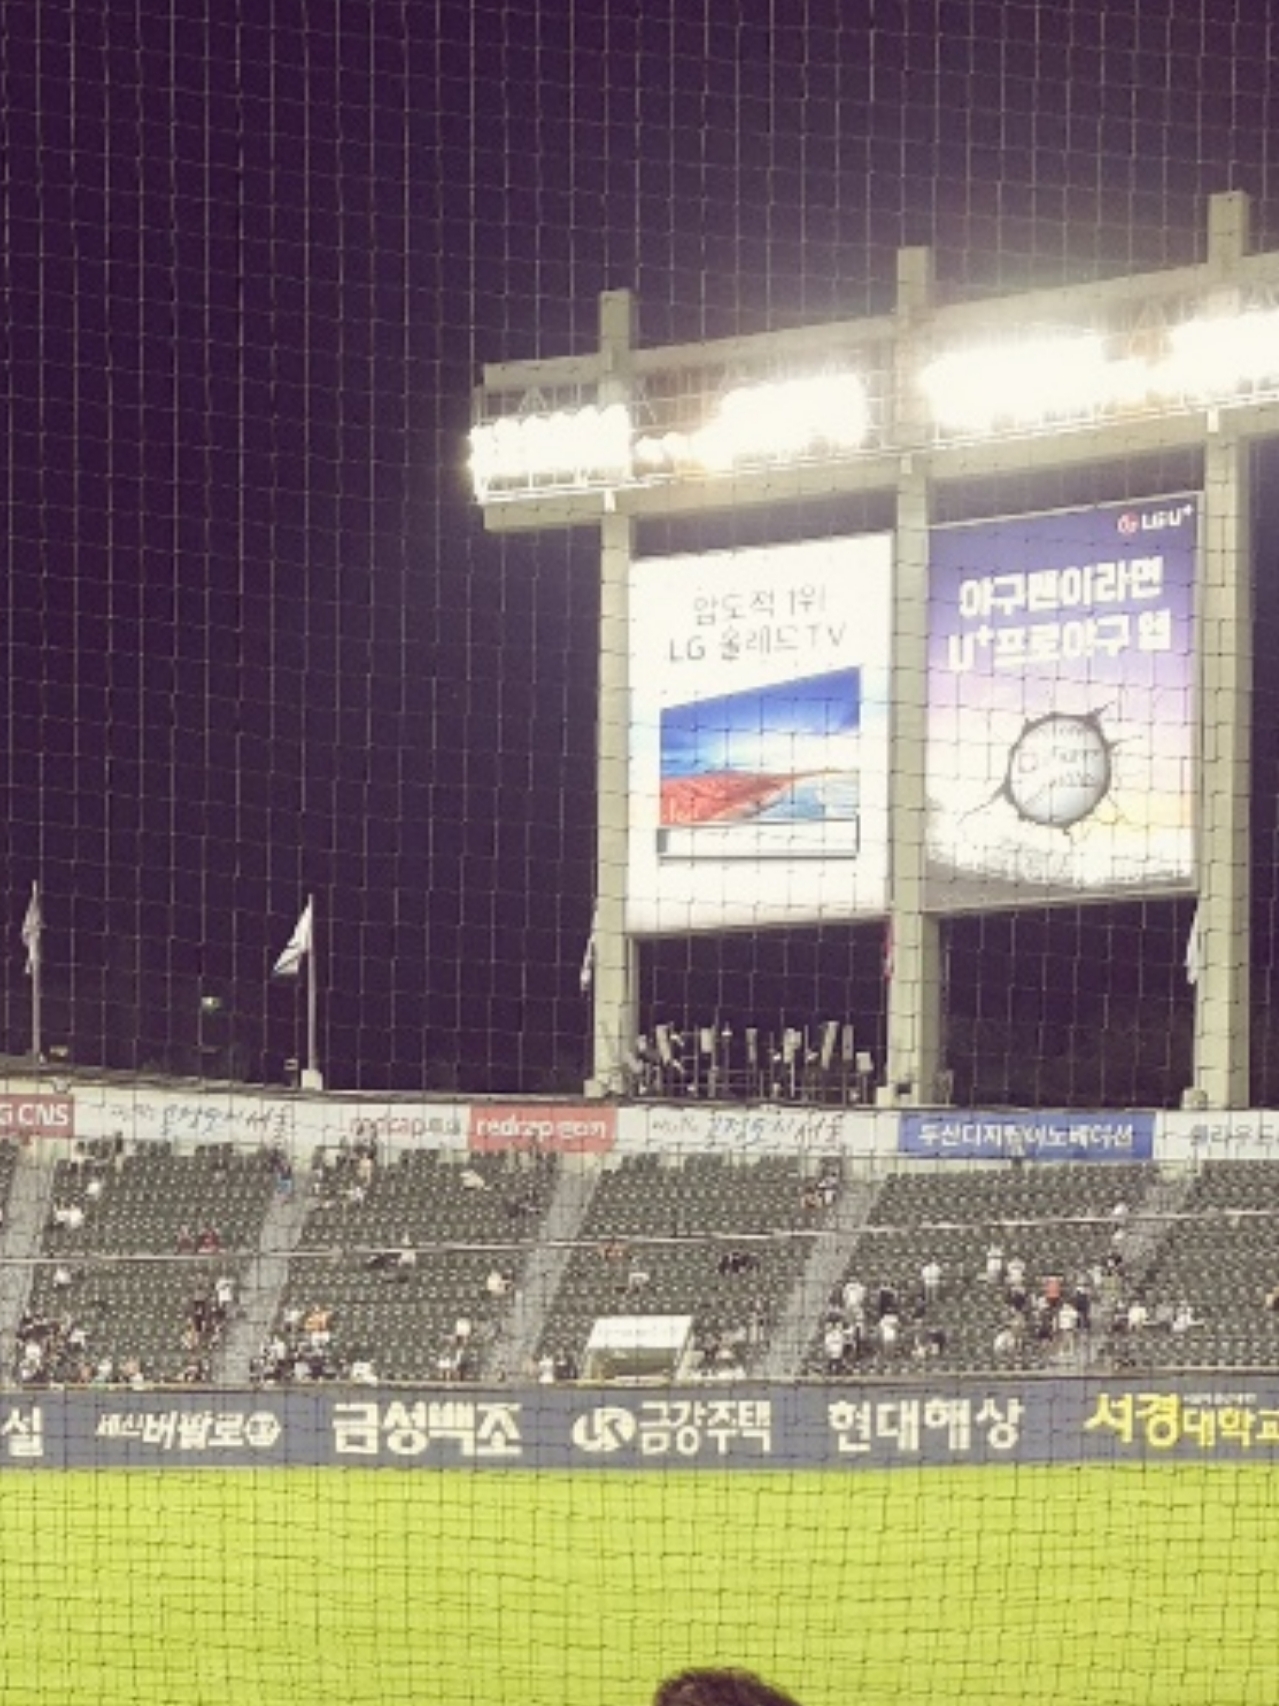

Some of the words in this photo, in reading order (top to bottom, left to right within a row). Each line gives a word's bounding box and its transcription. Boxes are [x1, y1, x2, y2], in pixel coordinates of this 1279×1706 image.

[669, 634, 706, 661] LG
[18, 1103, 70, 1127] CNS
[332, 1401, 522, 1455] 금성백조
[639, 1400, 771, 1455] 금강주택
[828, 1398, 1024, 1451] 현대해상
[1084, 1392, 1279, 1448] 서경대학교
